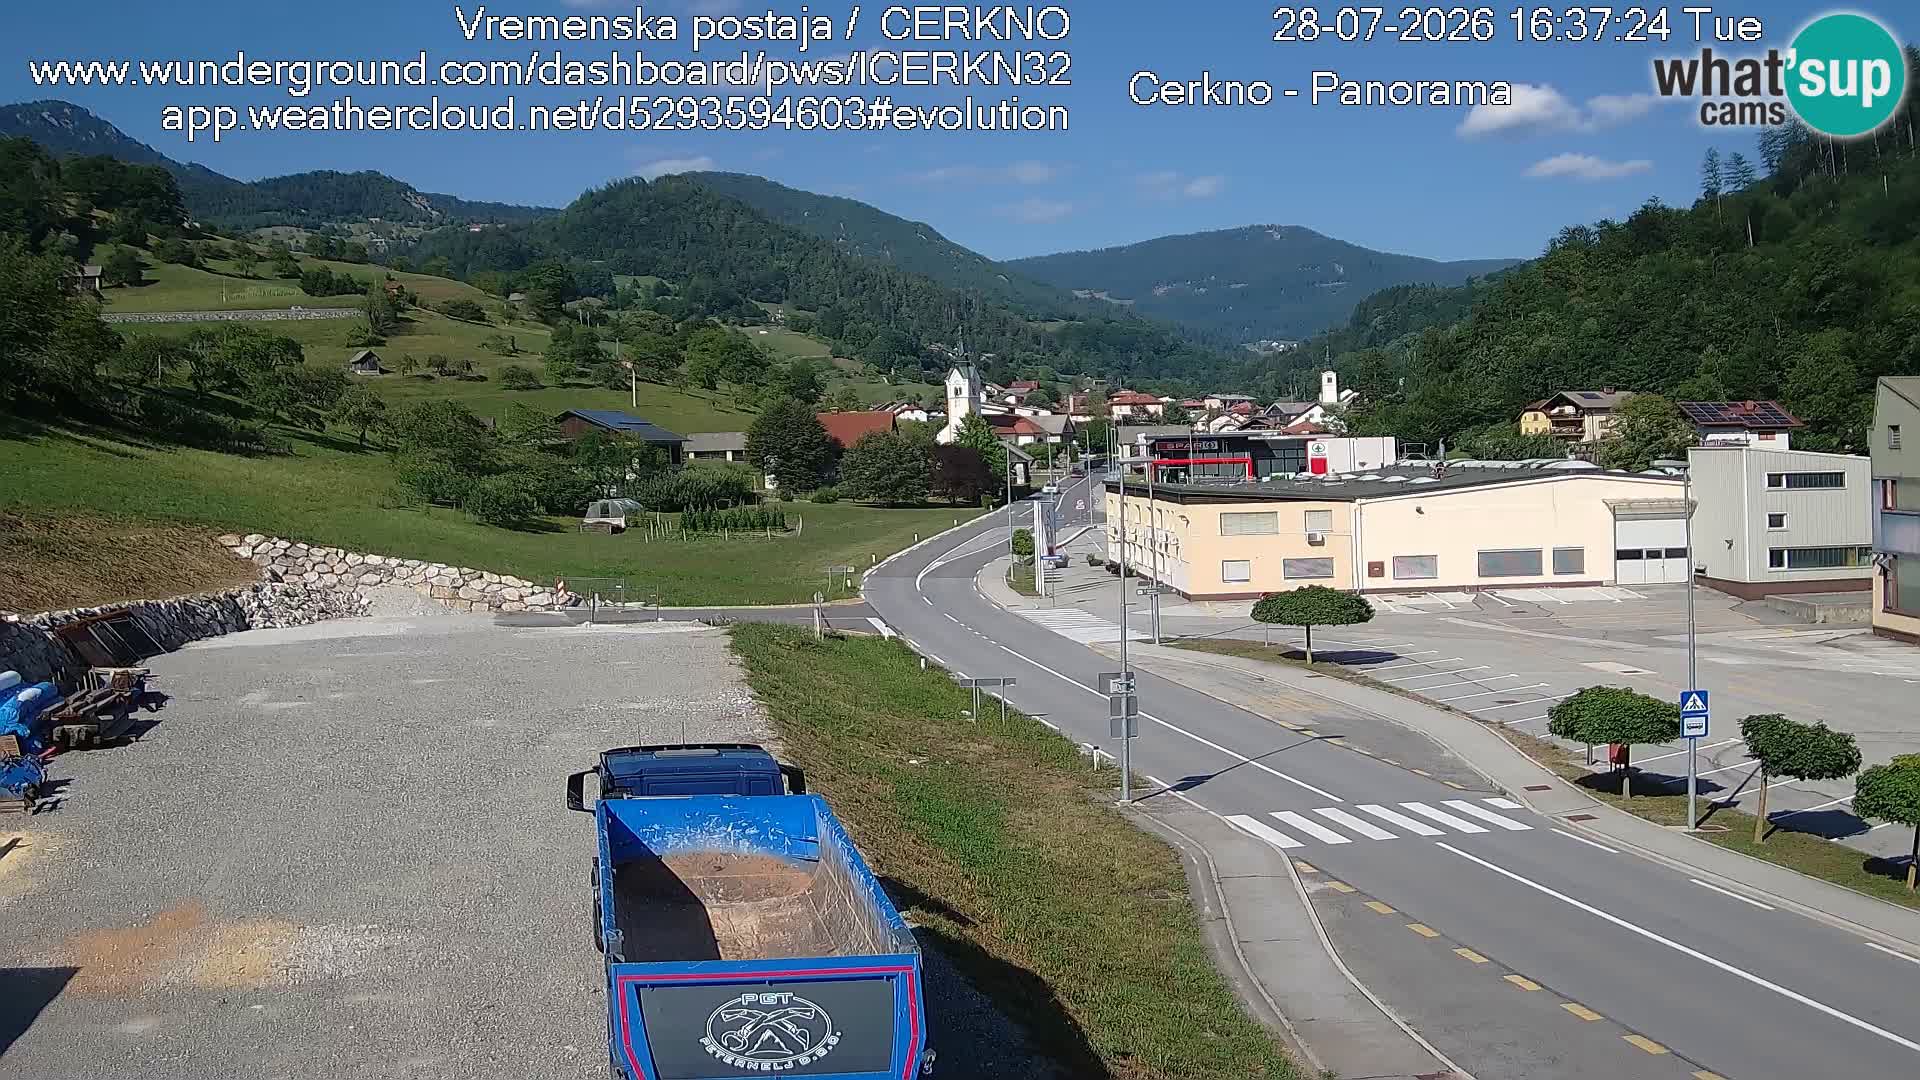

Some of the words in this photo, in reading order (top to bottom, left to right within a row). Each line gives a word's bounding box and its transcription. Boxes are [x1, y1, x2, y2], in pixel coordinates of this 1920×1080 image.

[1166, 442, 1202, 450] SPAR
[741, 992, 793, 1005] PGT
[699, 1036, 794, 1071] PETERNELJ
